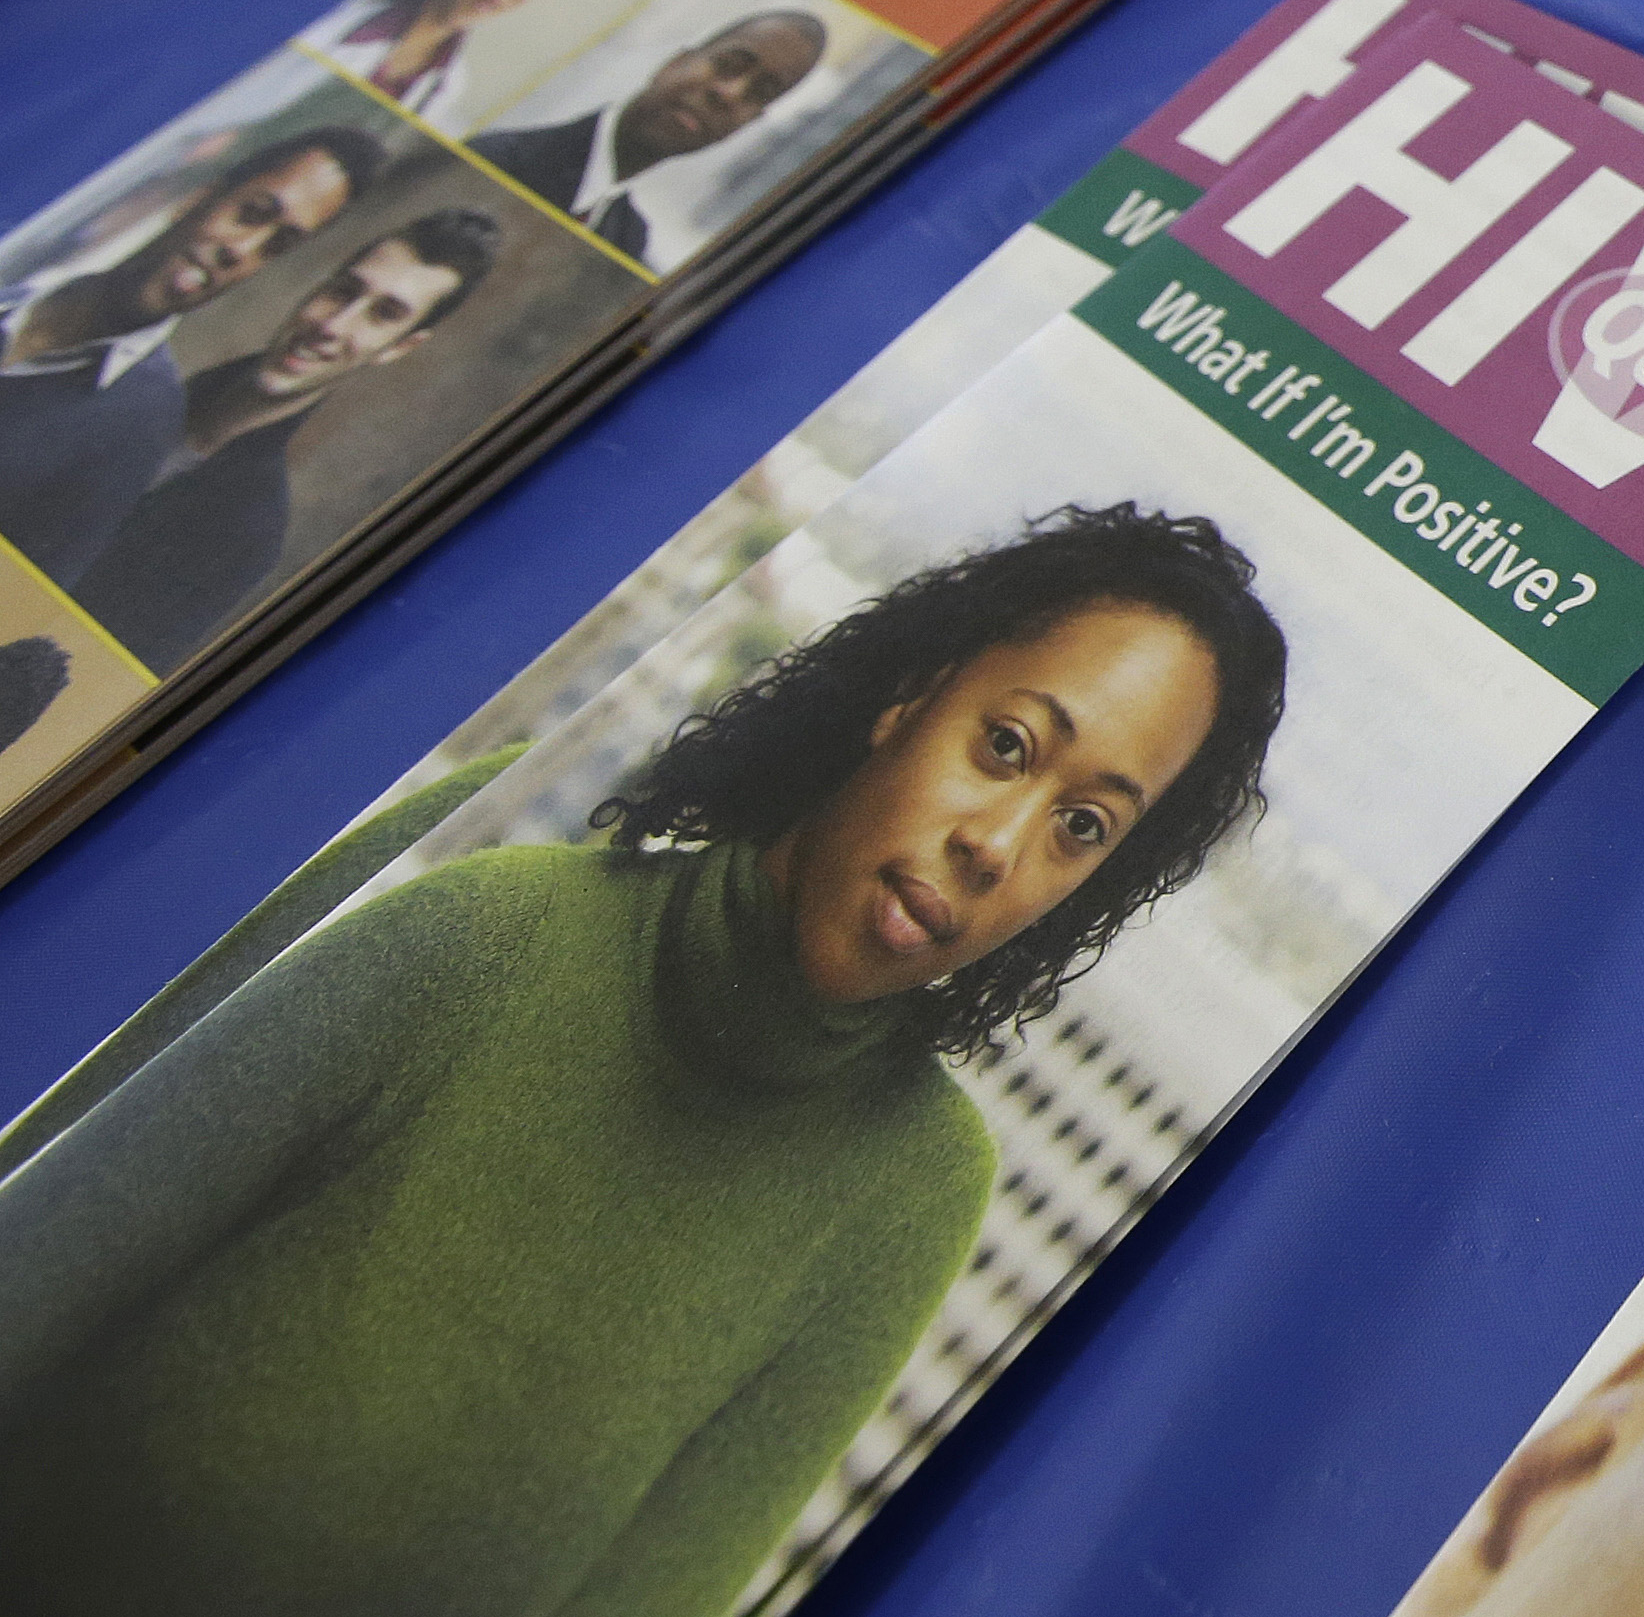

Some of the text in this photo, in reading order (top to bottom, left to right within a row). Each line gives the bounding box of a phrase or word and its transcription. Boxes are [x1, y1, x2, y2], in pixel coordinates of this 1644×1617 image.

[1136, 280, 1599, 629] What If I'm Positive?
